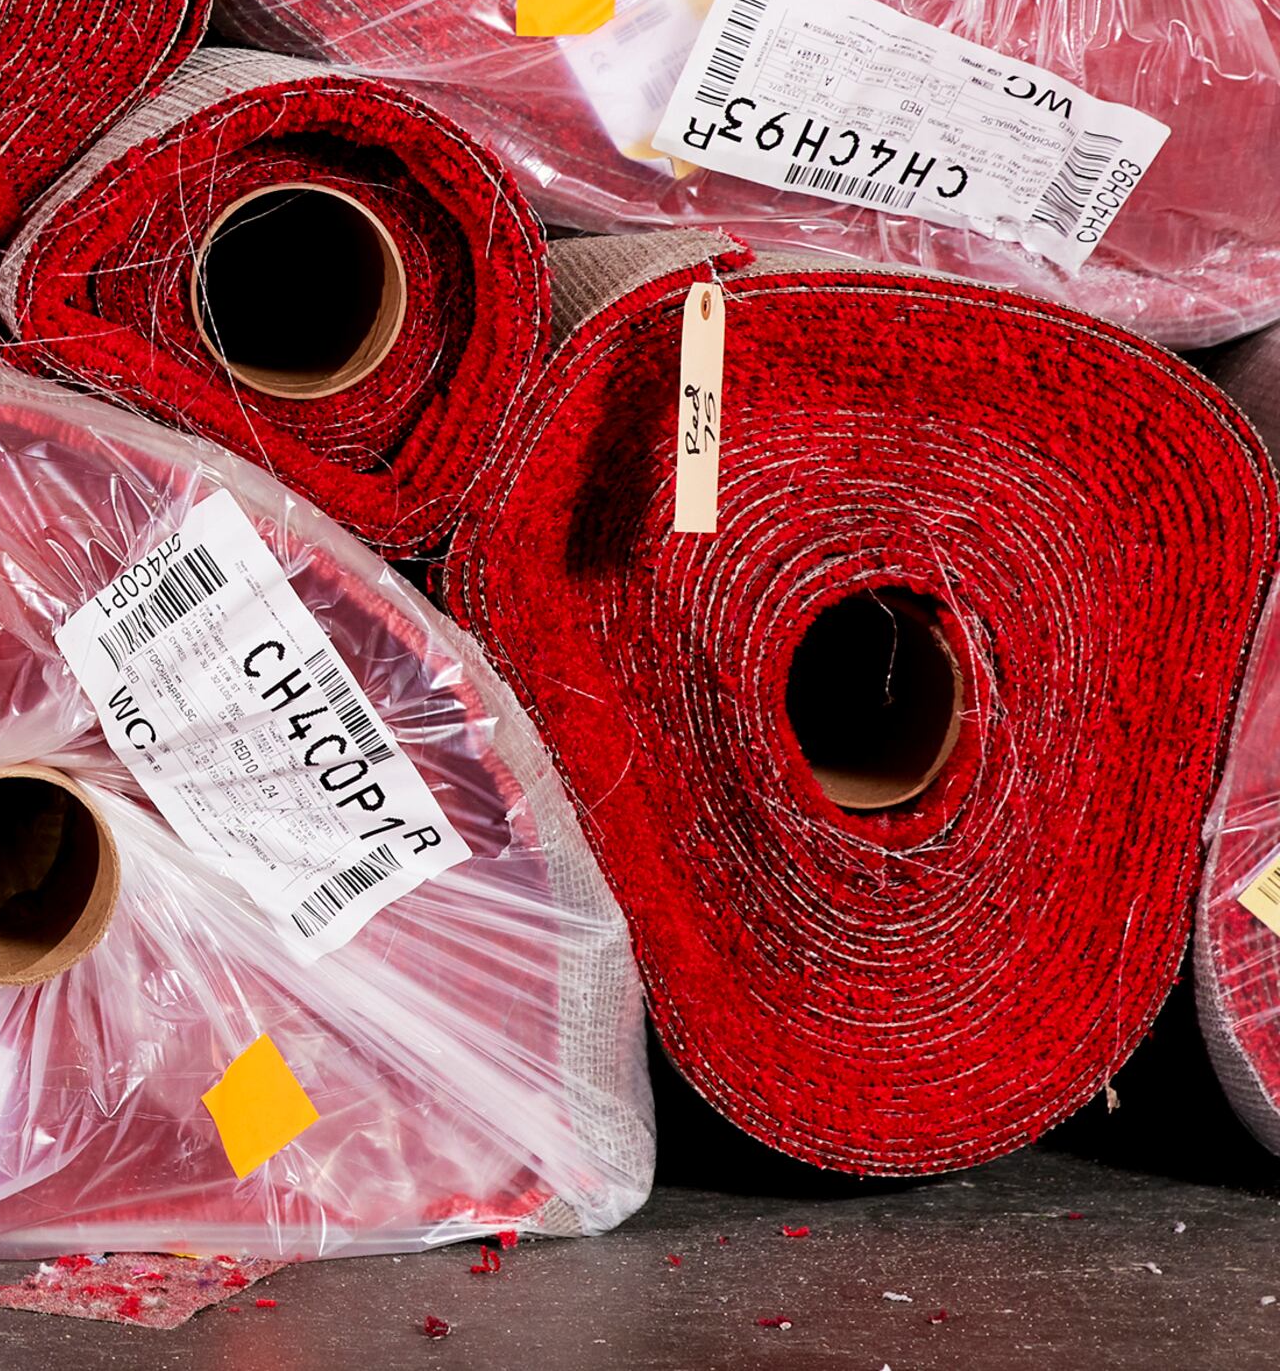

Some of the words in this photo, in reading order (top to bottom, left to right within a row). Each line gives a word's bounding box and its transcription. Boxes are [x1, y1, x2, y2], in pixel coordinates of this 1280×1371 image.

[824, 75, 835, 87] A
[1003, 75, 1074, 119] WC
[900, 100, 924, 116] RED
[682, 115, 720, 151] R
[716, 97, 969, 199] CH4CH93
[1076, 157, 1144, 244] CH4CH93
[122, 664, 139, 684] RED
[107, 685, 157, 750] WC
[402, 824, 443, 855] R
